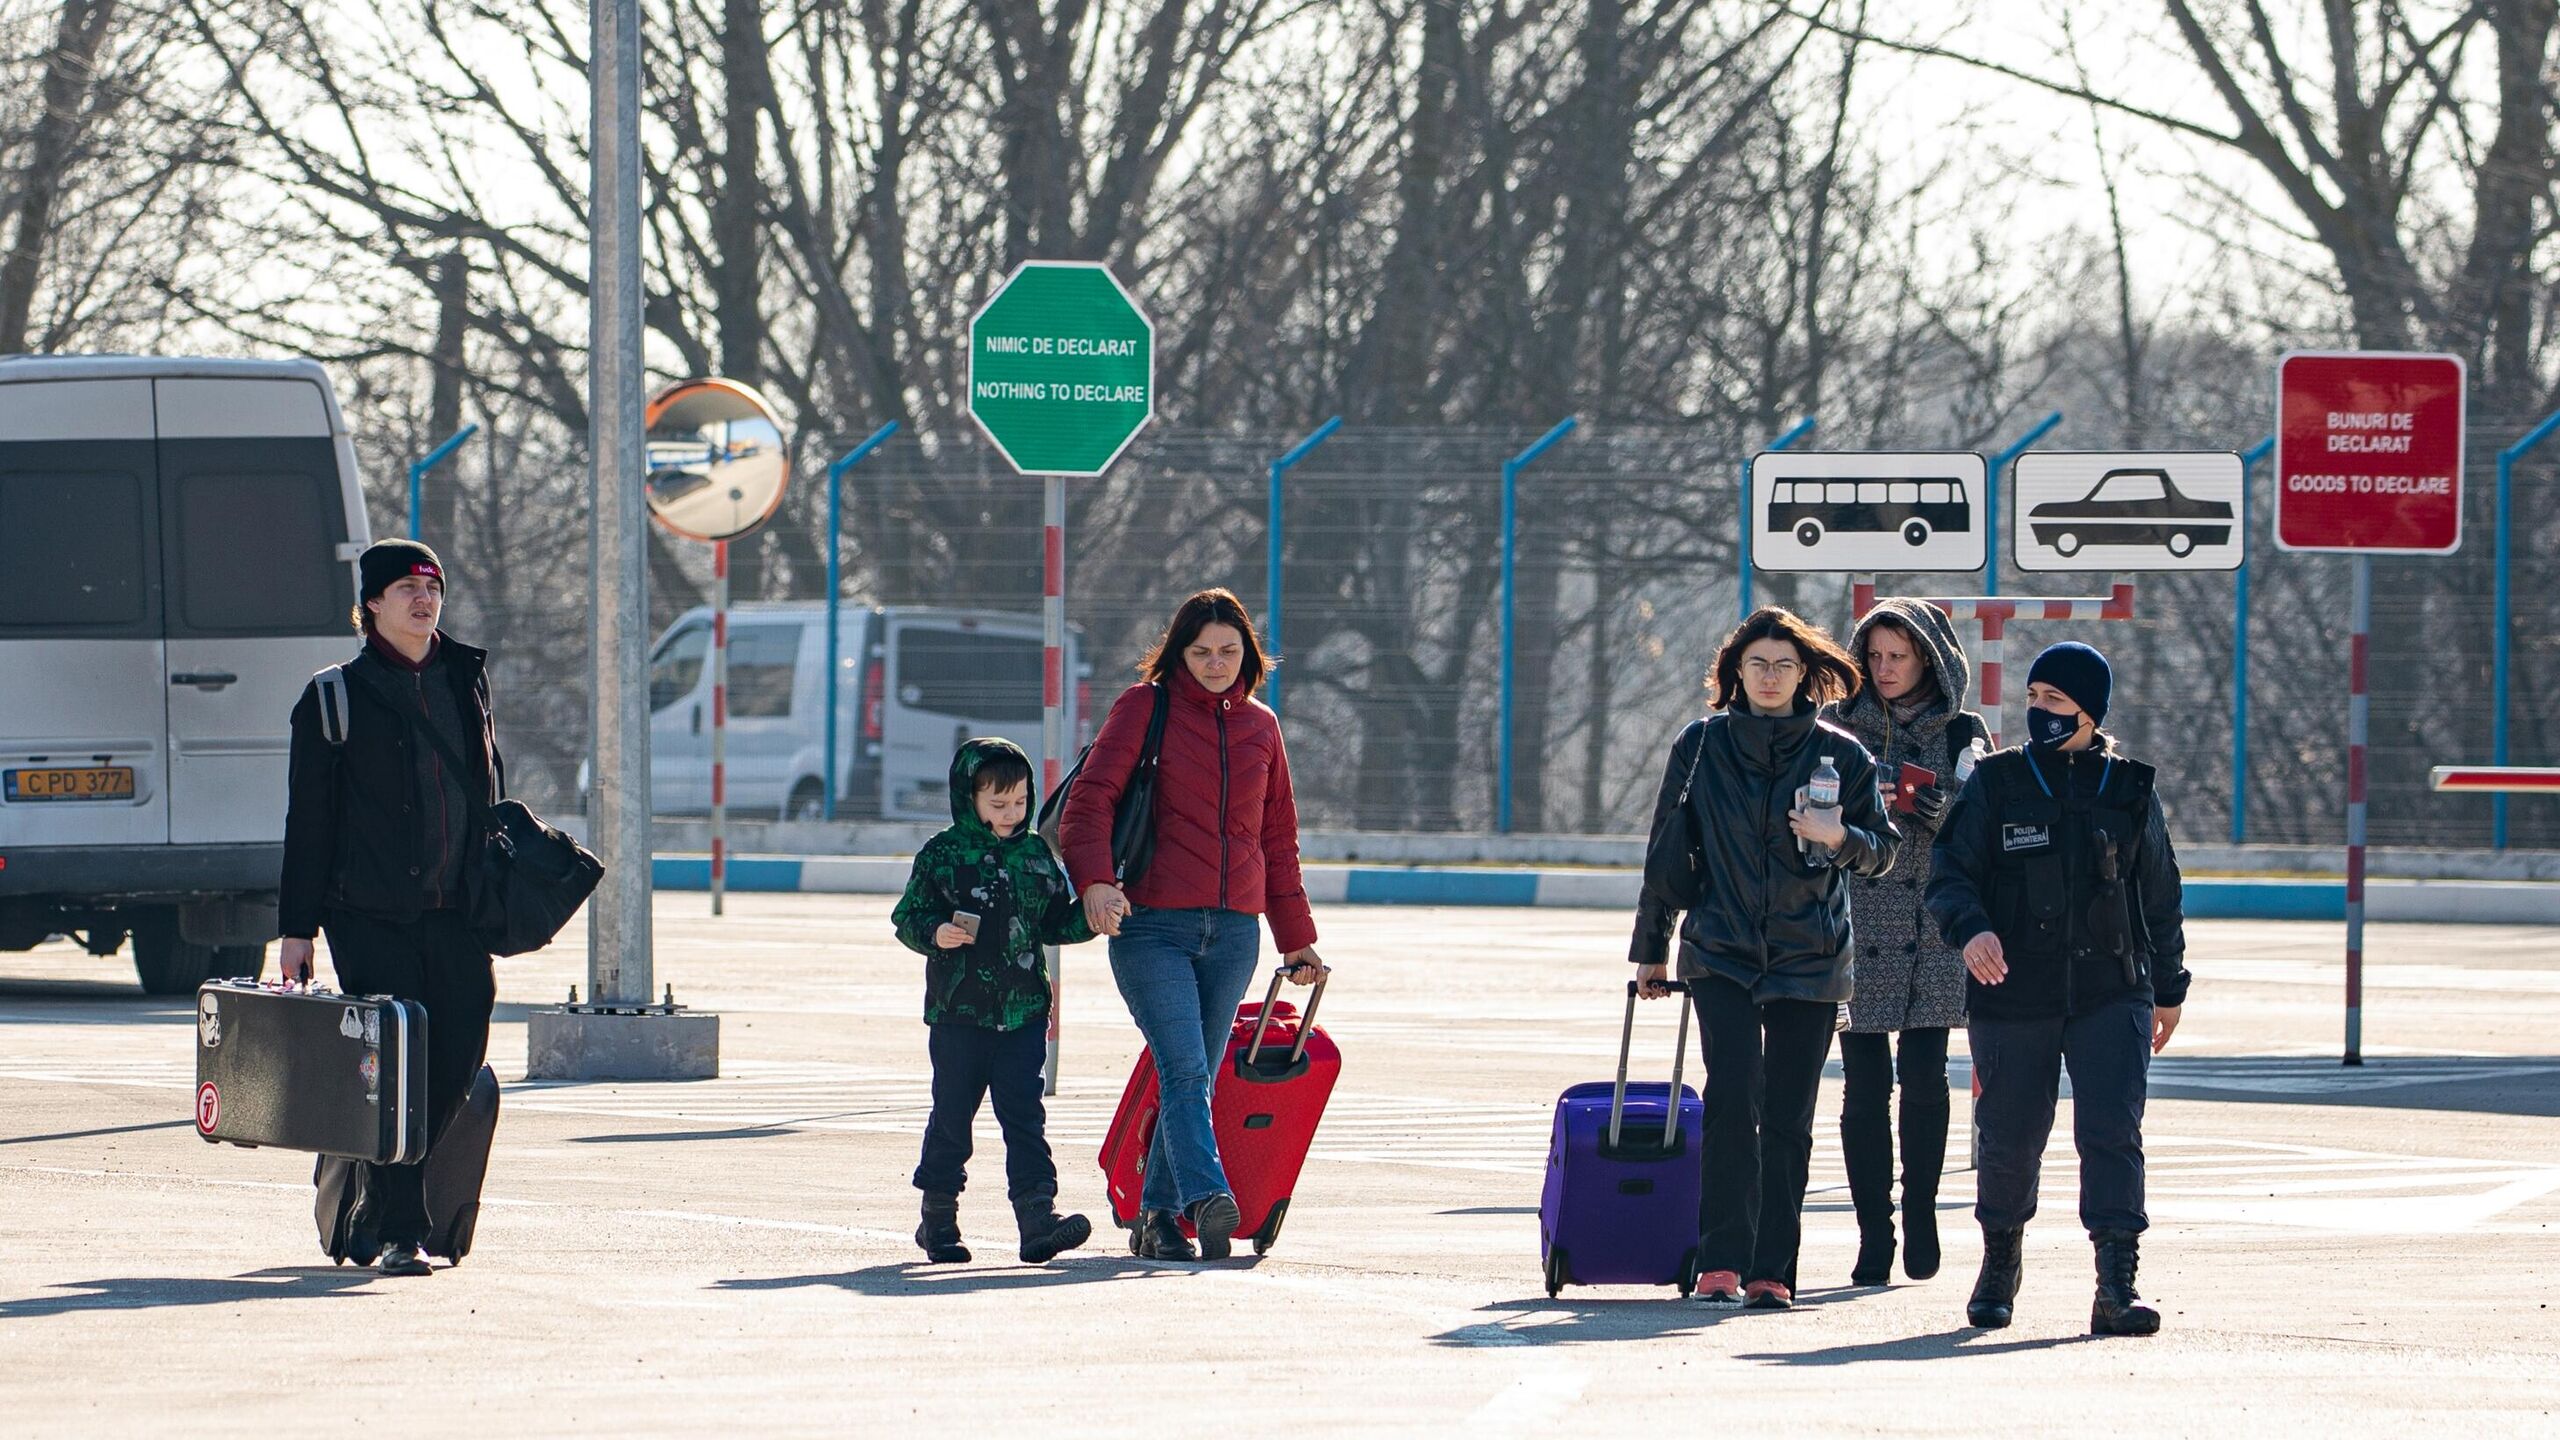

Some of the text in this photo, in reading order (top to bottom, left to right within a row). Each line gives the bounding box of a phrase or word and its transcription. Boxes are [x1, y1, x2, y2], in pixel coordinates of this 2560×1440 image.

[986, 336, 1137, 356] NIMIC DE DECLARAT
[977, 382, 1144, 402] NOTHING TO DECLARE
[2327, 412, 2414, 430] BUNURI DE
[2327, 435, 2412, 453] DECLARAT
[2288, 474, 2450, 494] GOODS TO DECLARE
[28, 771, 122, 793] C PD 377
